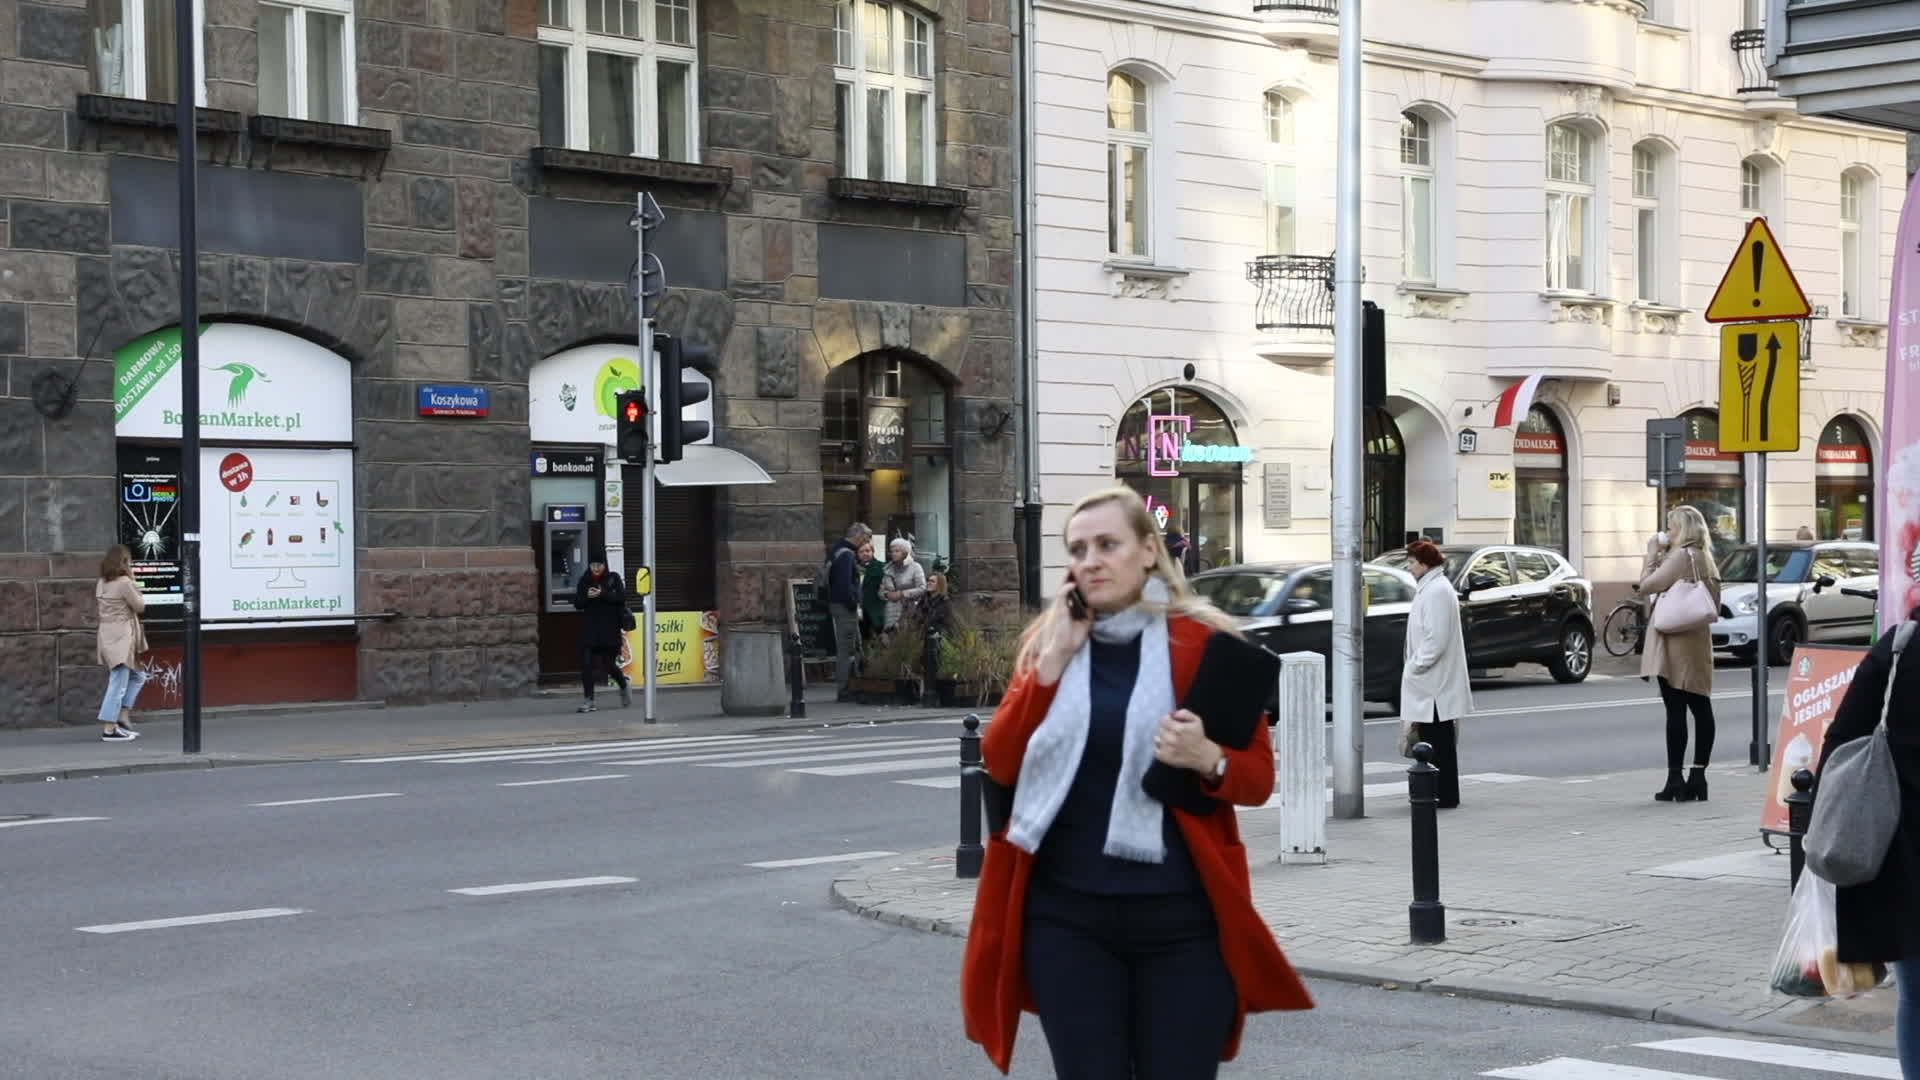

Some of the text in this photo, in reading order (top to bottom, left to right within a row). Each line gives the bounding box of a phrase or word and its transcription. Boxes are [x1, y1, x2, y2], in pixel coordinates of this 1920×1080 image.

[119, 339, 166, 386] DARMOWA
[114, 343, 182, 413] DOSTAWA od 150
[431, 393, 478, 408] Koszykowa
[163, 410, 301, 432] BoanMarket.pl
[552, 461, 594, 473] bankomat
[233, 596, 342, 612] BocianMarket.pl
[655, 619, 684, 633] osiłki
[662, 639, 687, 655] cały
[656, 658, 681, 673] zień
[1792, 695, 1832, 727] JESIEŃ
